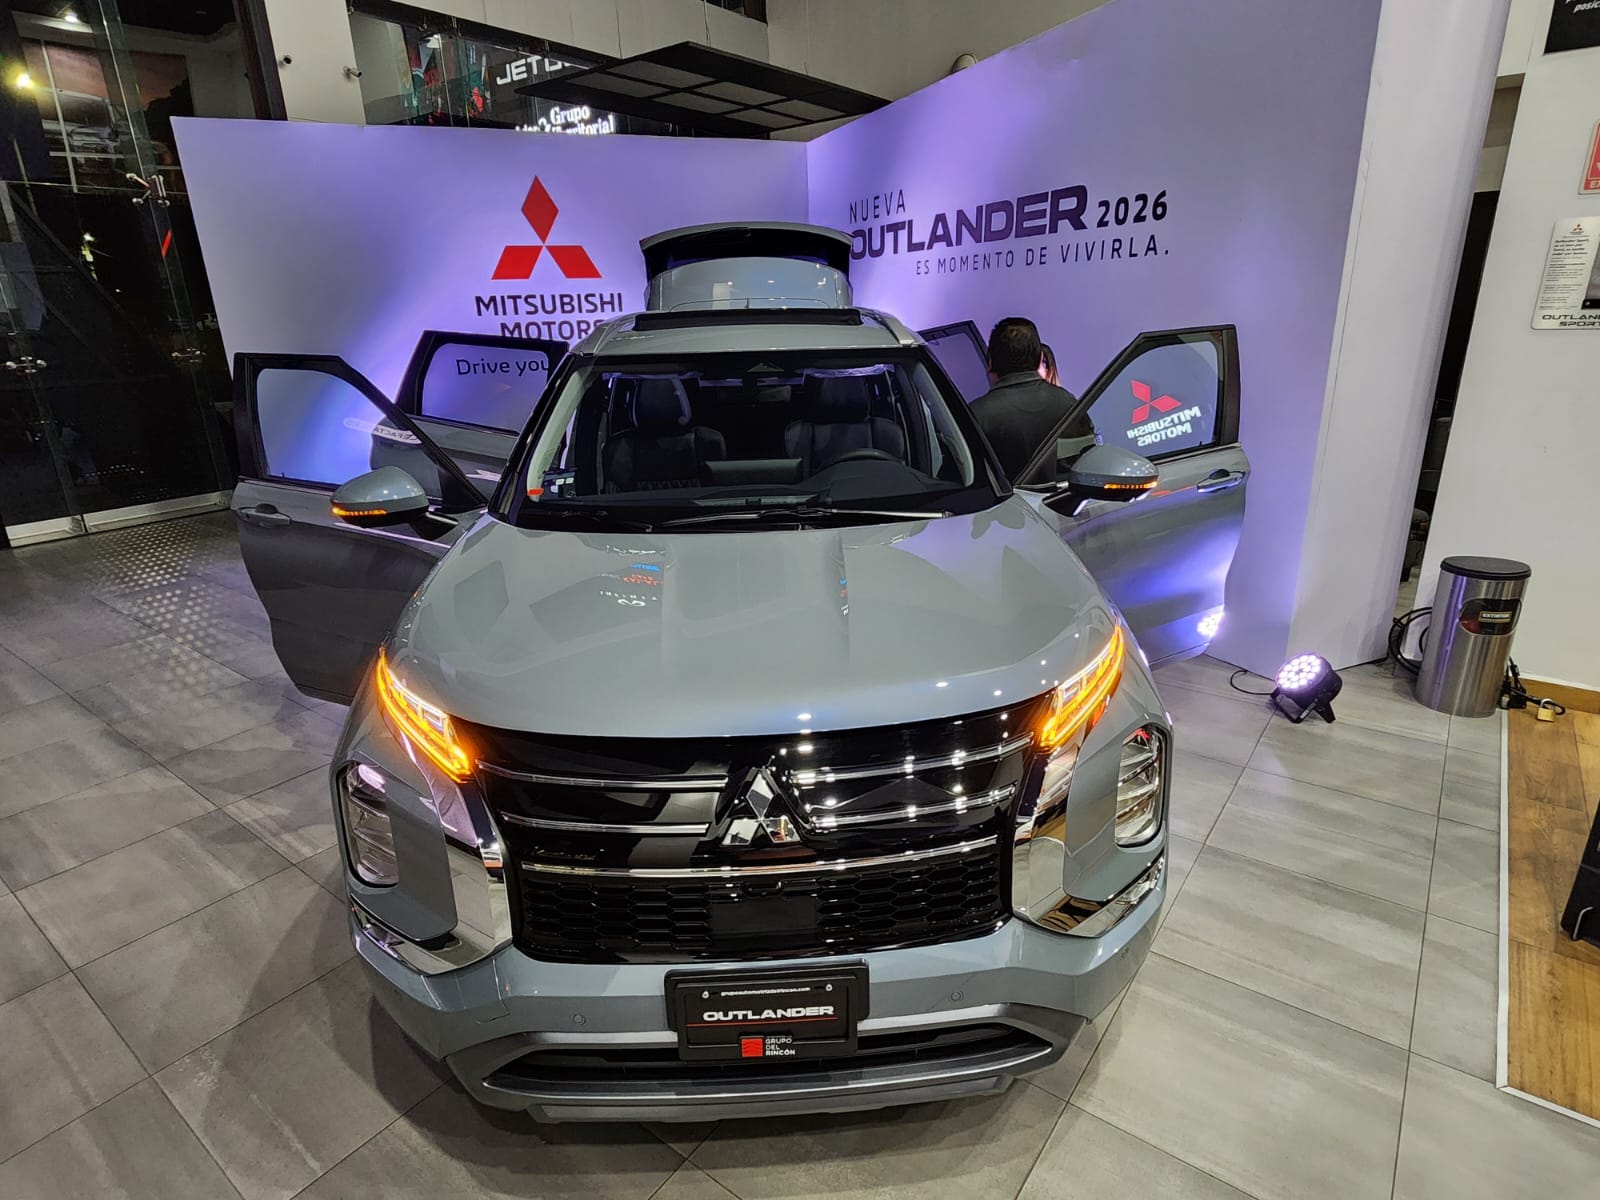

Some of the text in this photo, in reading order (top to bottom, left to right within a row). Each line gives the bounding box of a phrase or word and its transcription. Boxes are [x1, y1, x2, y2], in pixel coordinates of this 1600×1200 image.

[550, 105, 591, 124] Grupo
[849, 189, 906, 224] NUEVA
[850, 184, 1168, 260] OUTLANDER 2026
[916, 234, 1169, 276] ES MOMENTO DE VIVIRLA.
[475, 292, 623, 317] MITSUBISHI
[456, 358, 511, 375] Drive
[703, 1006, 834, 1021] OUTLANDER
